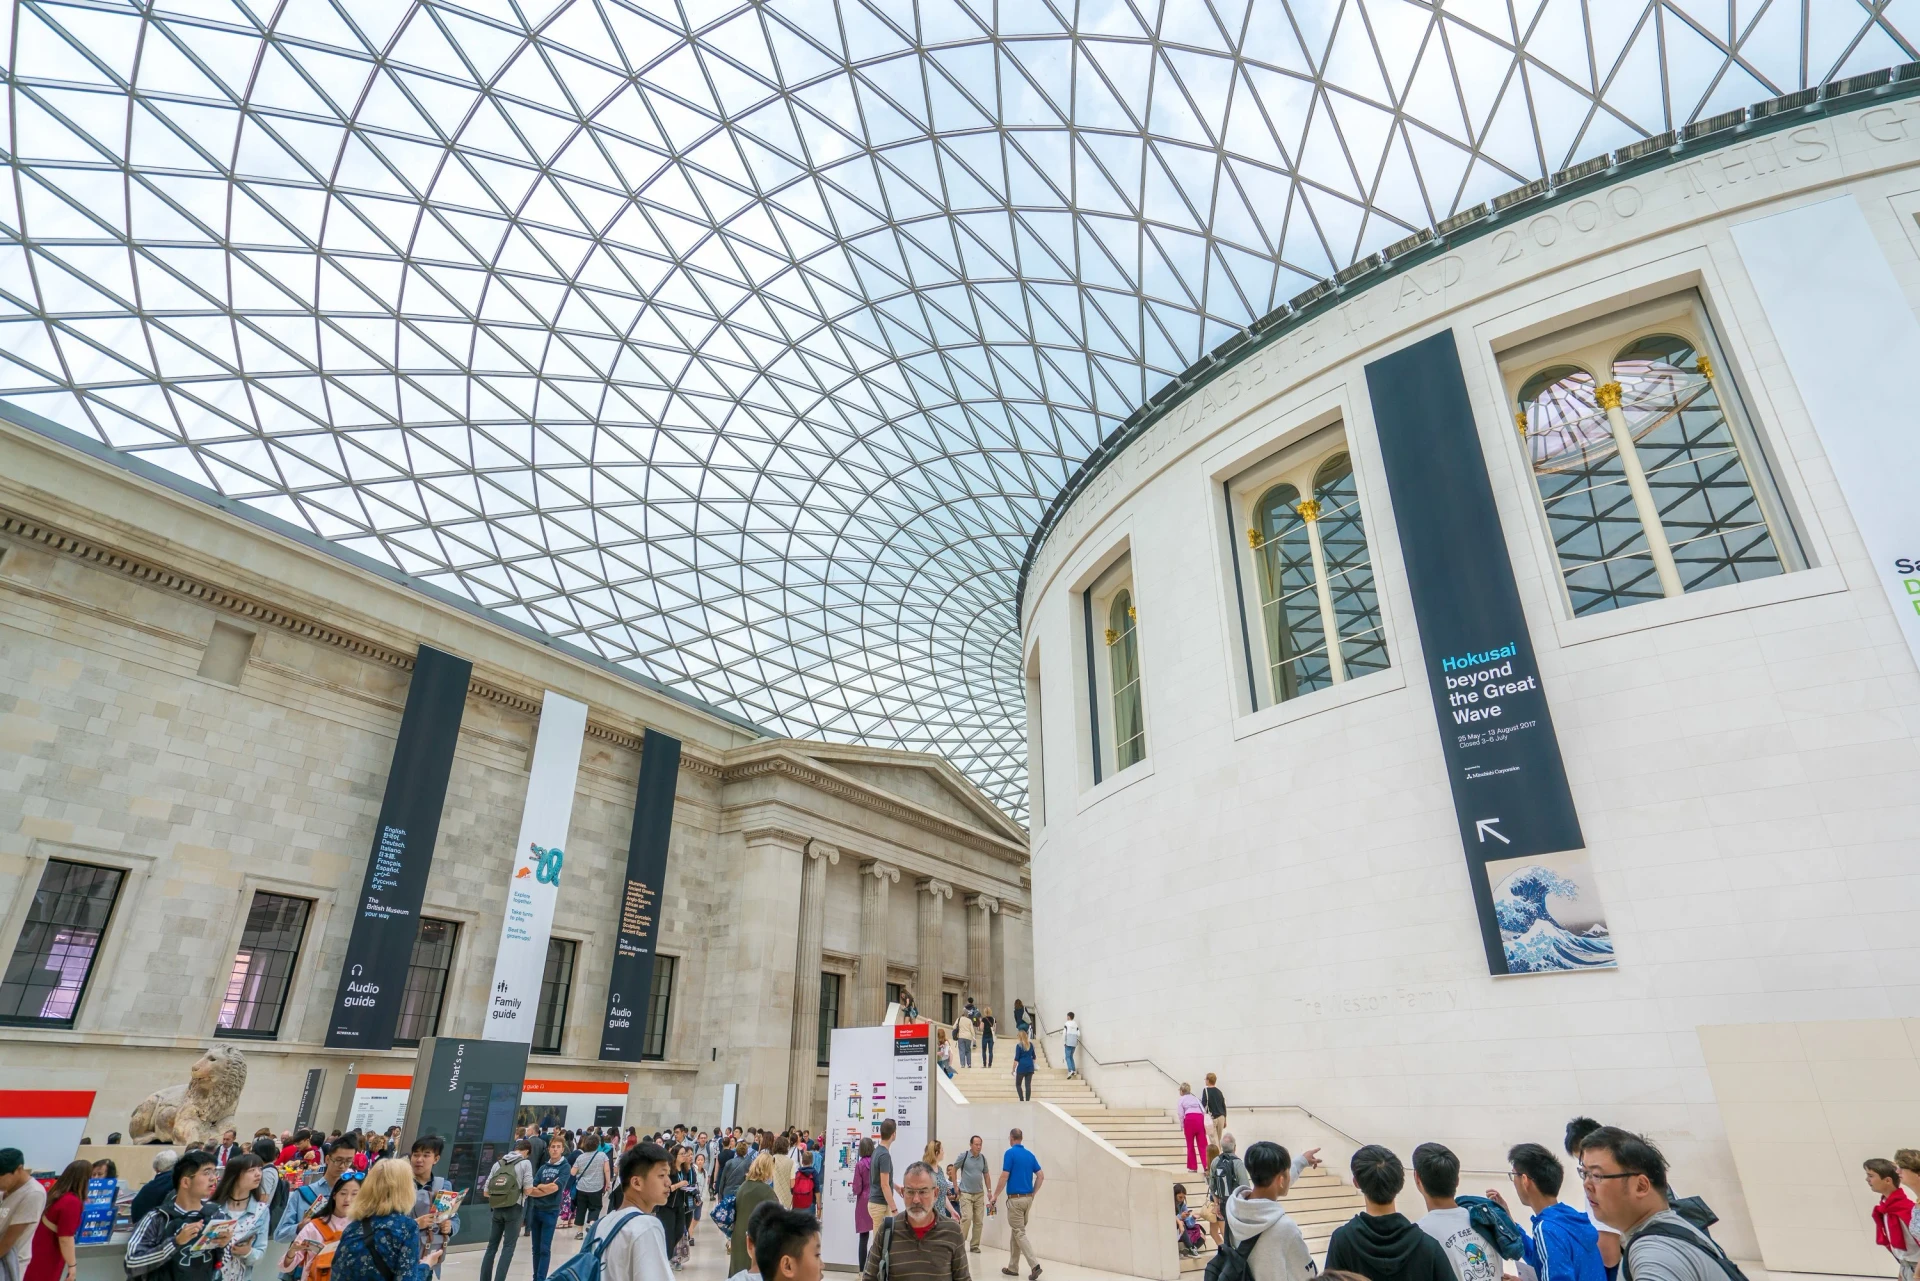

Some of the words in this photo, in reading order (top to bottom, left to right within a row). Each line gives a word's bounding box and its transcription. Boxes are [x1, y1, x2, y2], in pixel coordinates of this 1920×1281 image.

[1135, 319, 1326, 470] ELIZABETH
[1392, 255, 1466, 313] AD
[1490, 185, 1644, 266] 2000
[1663, 126, 1831, 200] THIS
[1442, 641, 1517, 673] Hokusai
[1445, 661, 1513, 690] beyond
[1449, 691, 1479, 707] the
[1483, 675, 1537, 699] Great
[1452, 705, 1502, 725] Wave
[1457, 735, 1467, 743] 25
[1467, 732, 1481, 742] May
[1487, 729, 1496, 737] 13
[1496, 724, 1520, 735] August
[1519, 720, 1537, 729] 2017
[1459, 738, 1481, 749] Closed
[1495, 733, 1508, 743] July
[1494, 766, 1521, 775] Corporation
[384, 826, 406, 836] English.
[381, 839, 405, 848] Deutsch.
[380, 845, 402, 854] Italiano.
[514, 891, 531, 899] Explore
[365, 911, 377, 919] your
[366, 904, 385, 912] British
[385, 906, 409, 915] Museum
[511, 908, 522, 916] Take
[522, 910, 533, 918] turns
[518, 927, 526, 935] the
[631, 945, 648, 954] Museum
[347, 981, 380, 994] Audio
[344, 996, 376, 1008] guide
[495, 996, 522, 1009] Family
[492, 1009, 517, 1020] guide
[610, 1006, 632, 1018] Audio
[609, 1018, 630, 1029] guide
[448, 1058, 463, 1092] What's
[457, 1044, 465, 1056] on
[305, 1072, 313, 1090] point
[526, 1083, 539, 1091] guide
